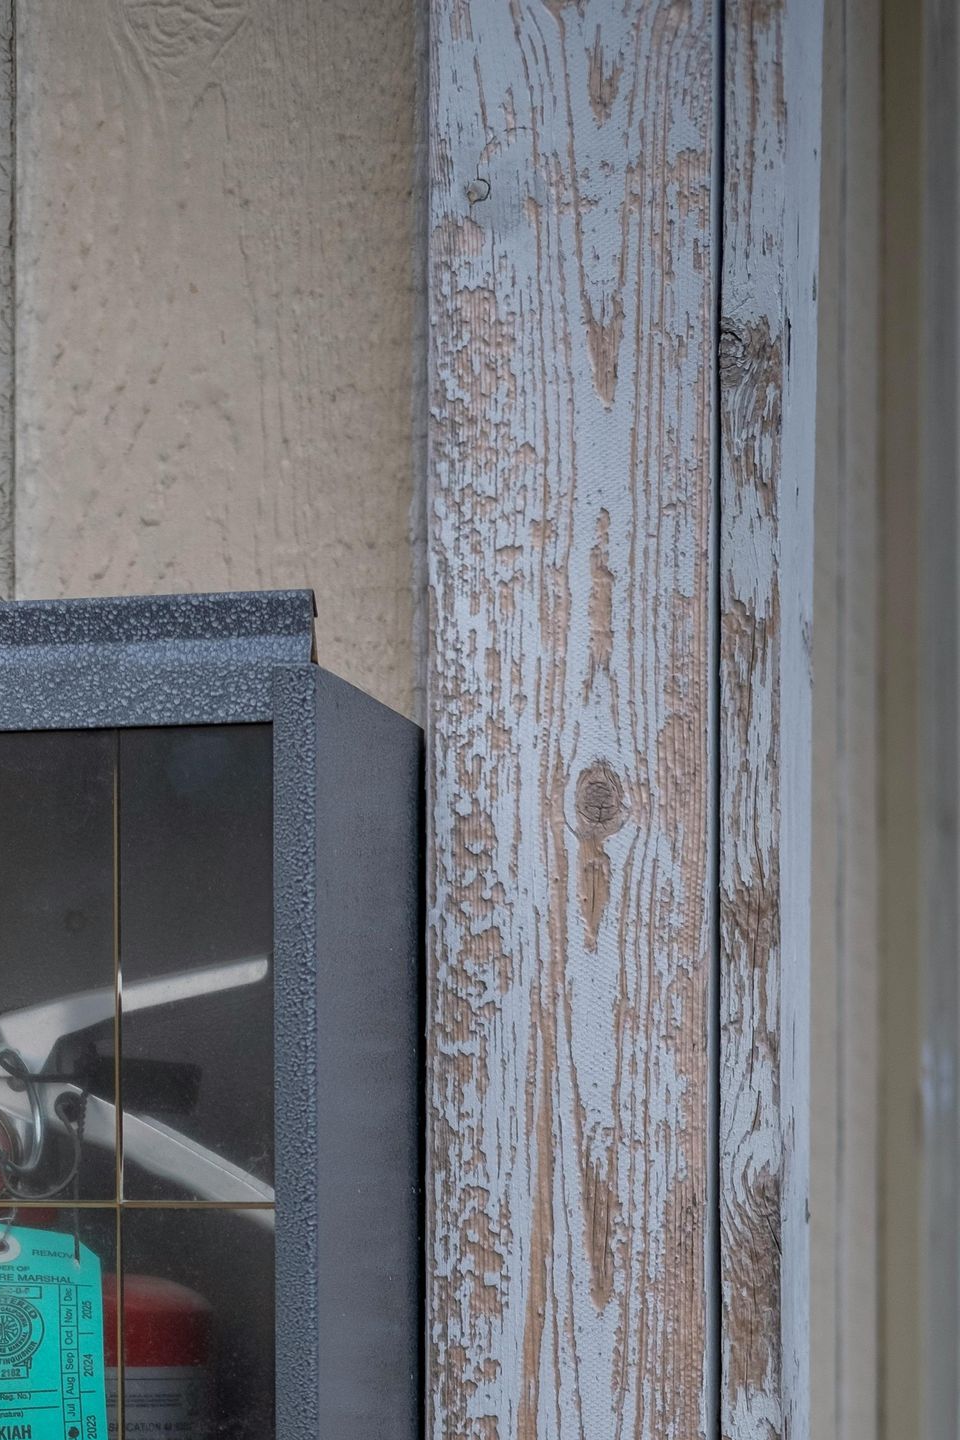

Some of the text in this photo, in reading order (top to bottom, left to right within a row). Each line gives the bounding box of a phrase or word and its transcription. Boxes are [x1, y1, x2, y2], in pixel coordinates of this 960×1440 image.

[32, 1248, 74, 1259] REMOV
[16, 1264, 30, 1272] OF
[18, 1273, 74, 1284] MARSHAL
[64, 1288, 73, 1302] Dec
[64, 1308, 73, 1323] Nov
[65, 1330, 73, 1345] Oct
[66, 1352, 75, 1370] Sep
[83, 1354, 94, 1377] 2024
[66, 1377, 76, 1395] Aug
[0, 1394, 14, 1402] Reg.
[16, 1392, 31, 1401] No.)
[67, 1403, 76, 1417] Jul
[86, 1414, 97, 1439] 2023
